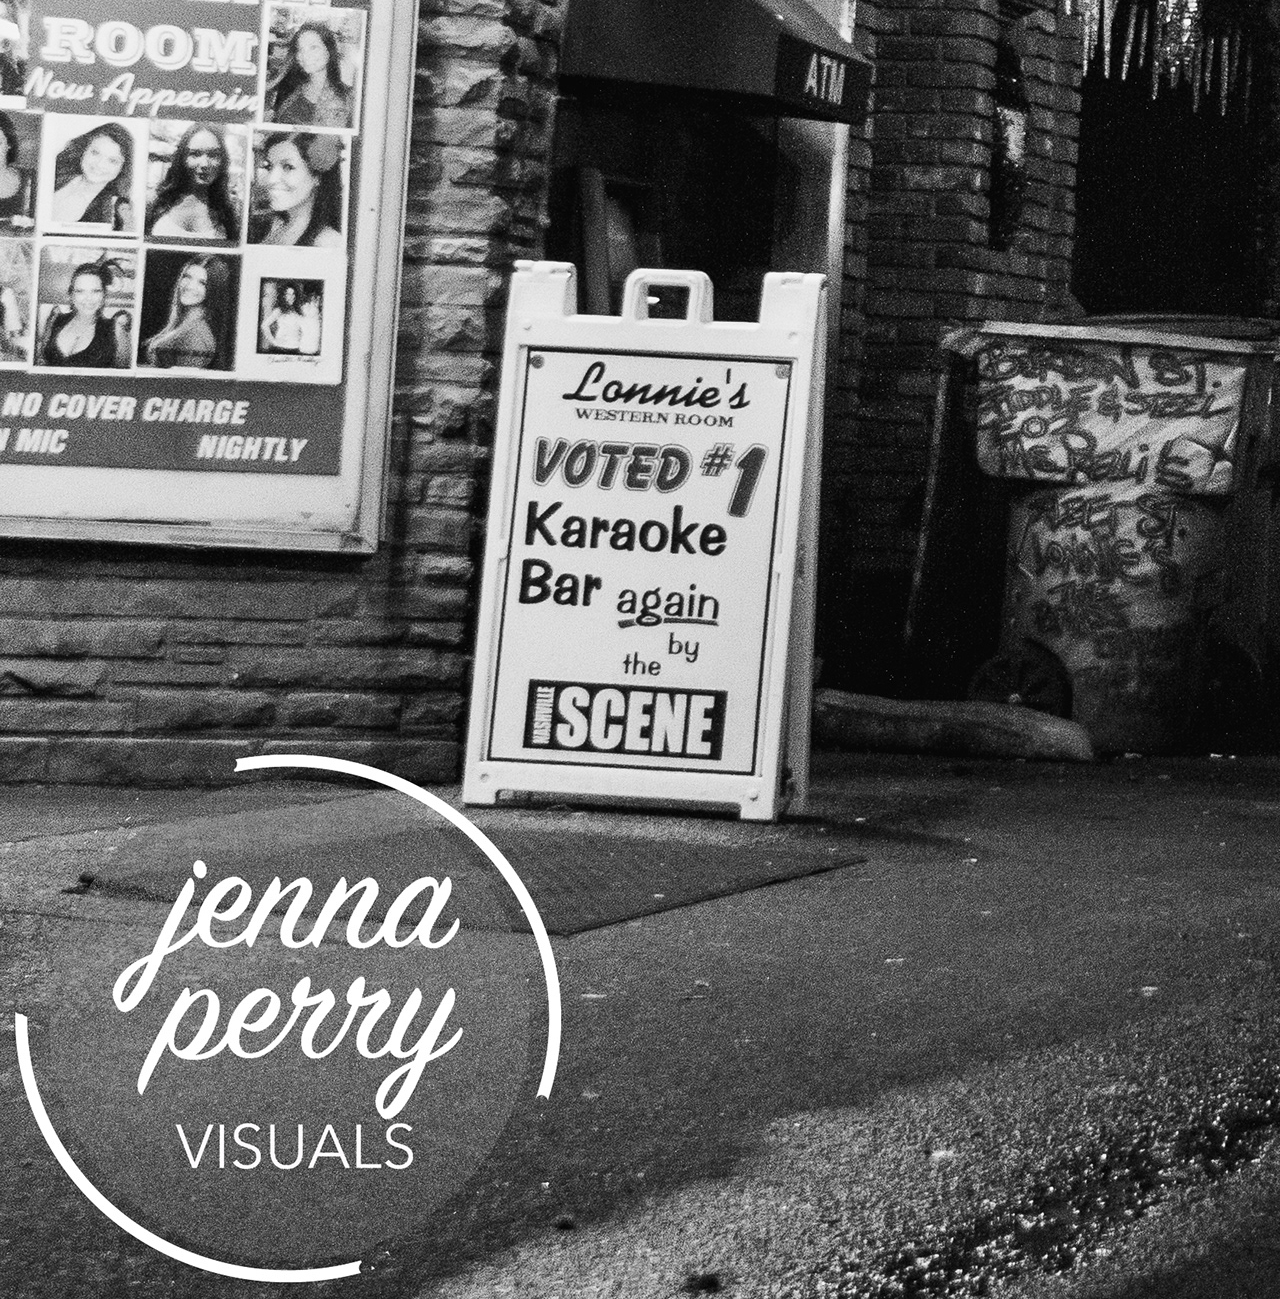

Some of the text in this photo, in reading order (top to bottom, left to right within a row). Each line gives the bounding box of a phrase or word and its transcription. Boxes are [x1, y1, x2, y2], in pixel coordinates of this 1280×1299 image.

[40, 16, 259, 77] ROOM
[24, 67, 259, 117] Now Appearin
[804, 53, 846, 105] ATM
[2, 391, 250, 425] NO COVER CHARGE
[562, 361, 751, 410] Lonnie's
[575, 407, 734, 428] WESTERN ROOM
[15, 428, 69, 454] MIC
[197, 434, 308, 463] NIGHTLY
[531, 436, 770, 519] VOTED #1
[524, 501, 728, 557] Karaoke
[518, 558, 720, 628] Bar again
[622, 652, 662, 677] the
[668, 632, 700, 663] by
[556, 686, 715, 756] SCENE
